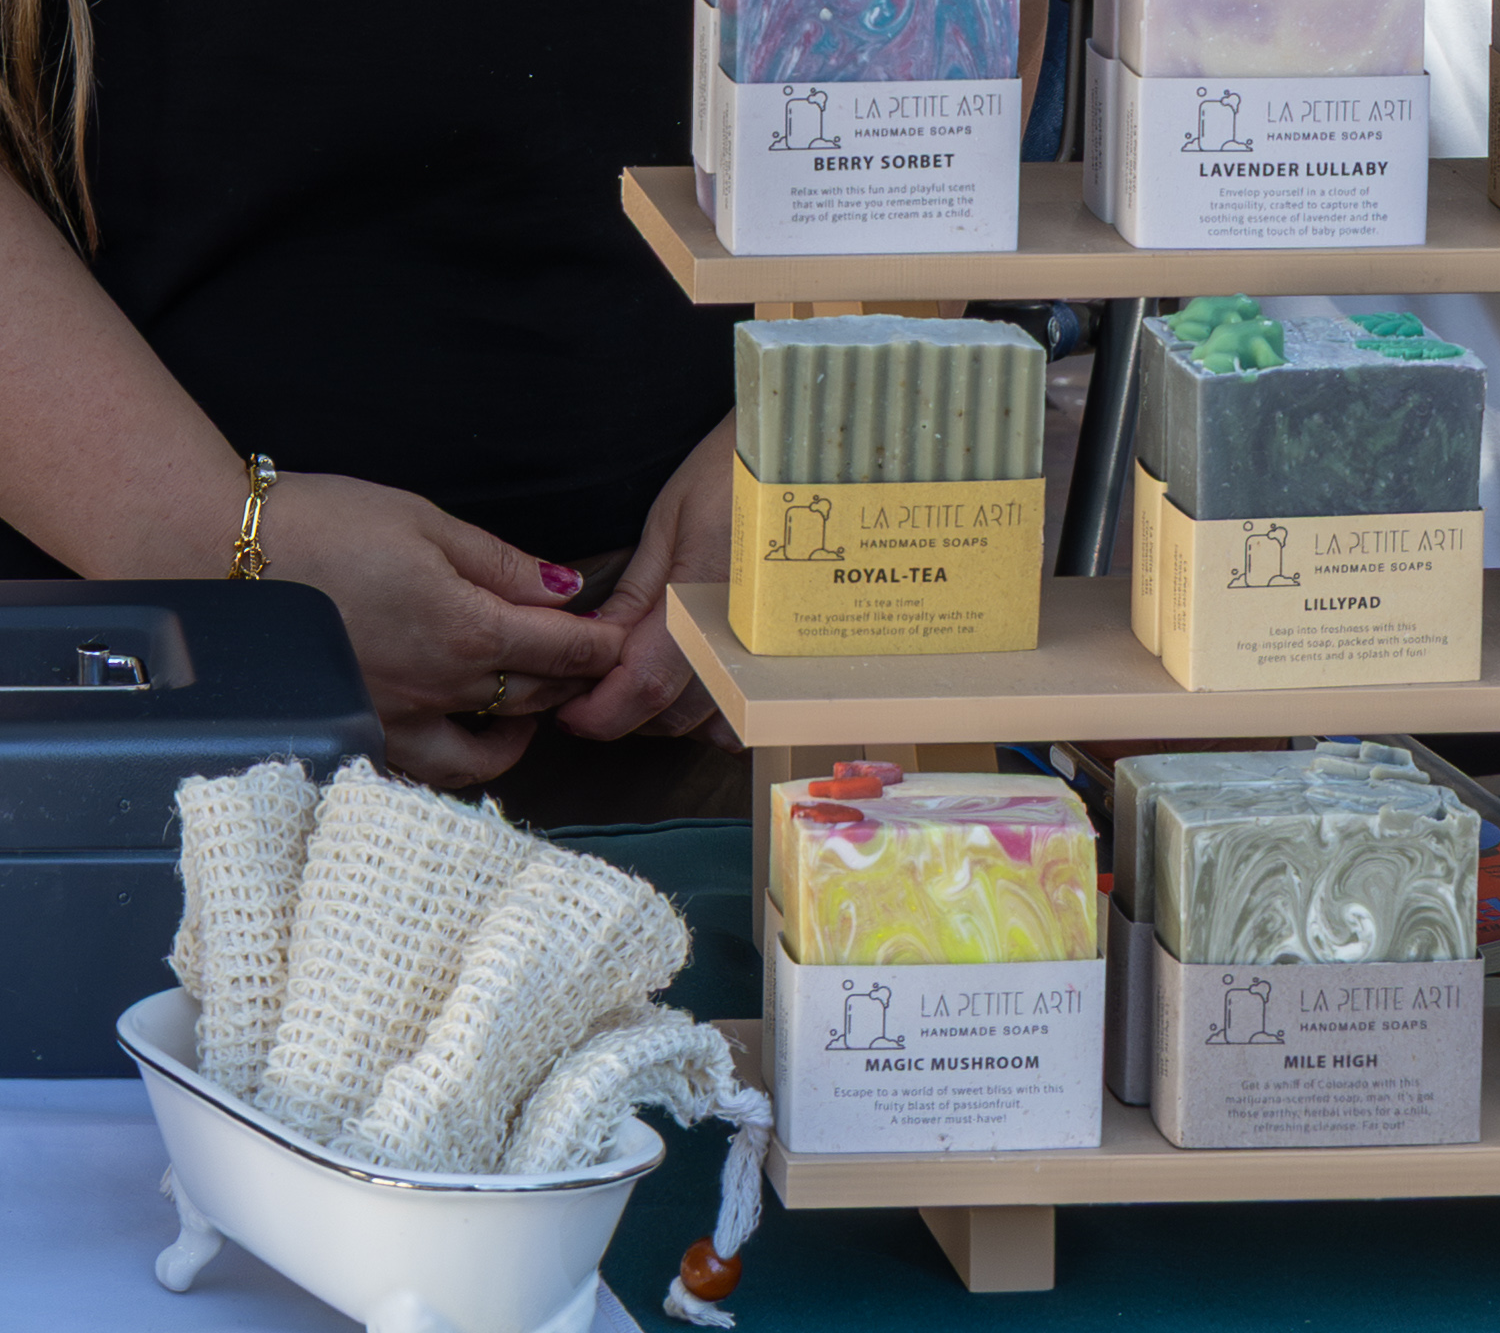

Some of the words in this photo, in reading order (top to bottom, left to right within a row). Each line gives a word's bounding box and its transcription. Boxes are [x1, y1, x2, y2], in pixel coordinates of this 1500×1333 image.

[813, 155, 874, 172] BERRY
[880, 153, 955, 170] SORBET
[1199, 162, 1299, 177] LAVENDER
[1306, 161, 1389, 177] LULLABY
[833, 567, 948, 584] ROYAL-TEA
[1304, 596, 1381, 612] LILLYPAD
[865, 1057, 925, 1072] MAGIC
[930, 1055, 1039, 1071] MUSHROOM
[1283, 1054, 1326, 1070] MILE
[1332, 1053, 1378, 1069] HIGH
